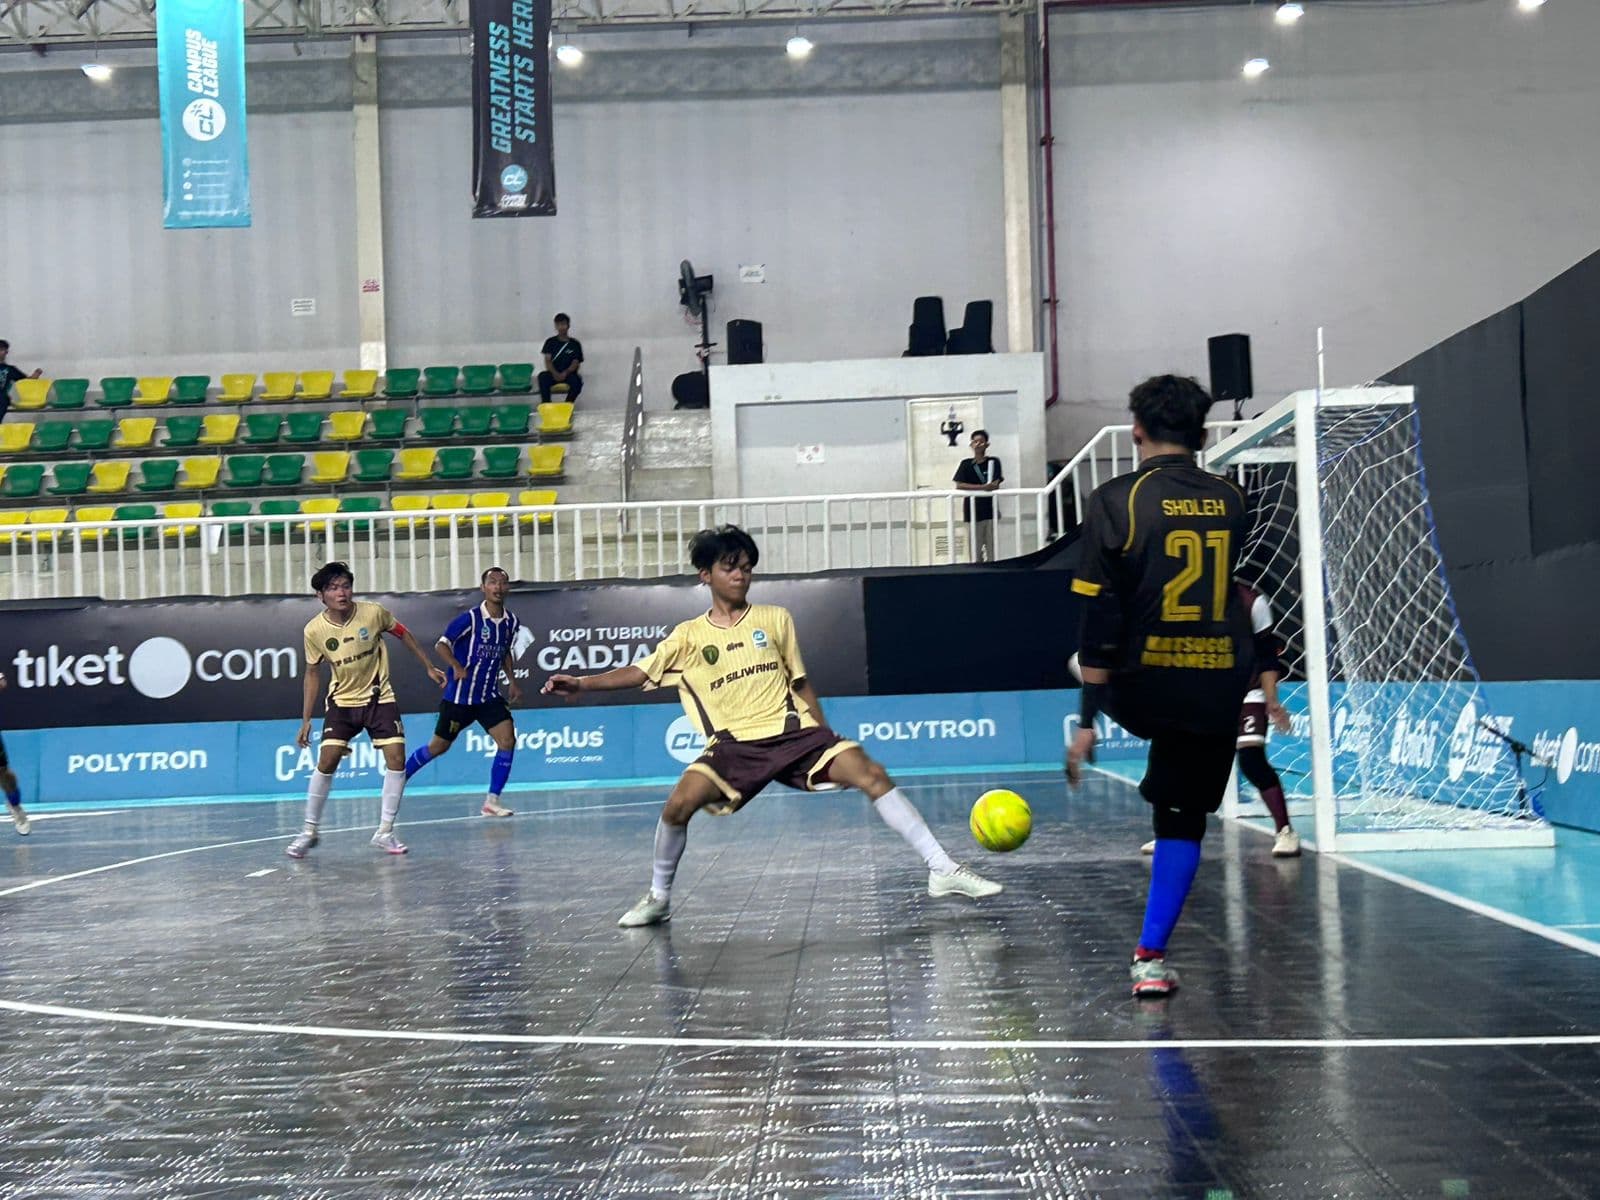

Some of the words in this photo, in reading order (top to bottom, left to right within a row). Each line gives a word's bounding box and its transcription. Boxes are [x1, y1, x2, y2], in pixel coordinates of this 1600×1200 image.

[512, 0, 534, 50] HER
[185, 28, 204, 94] CAMPUS
[202, 37, 220, 98] LEAGUE
[489, 21, 512, 154] GREATNESS
[514, 54, 536, 144] STARTS
[1162, 499, 1226, 516] SHOLEH
[1160, 529, 1231, 622] 21
[550, 628, 591, 643] KOPI
[595, 625, 668, 641] TUBRUK
[537, 643, 657, 672] GADJA
[858, 718, 996, 741] POLYTRON
[1244, 715, 1256, 733] 2
[465, 725, 604, 758] hyroplus
[67, 749, 208, 774] POLYTRON
